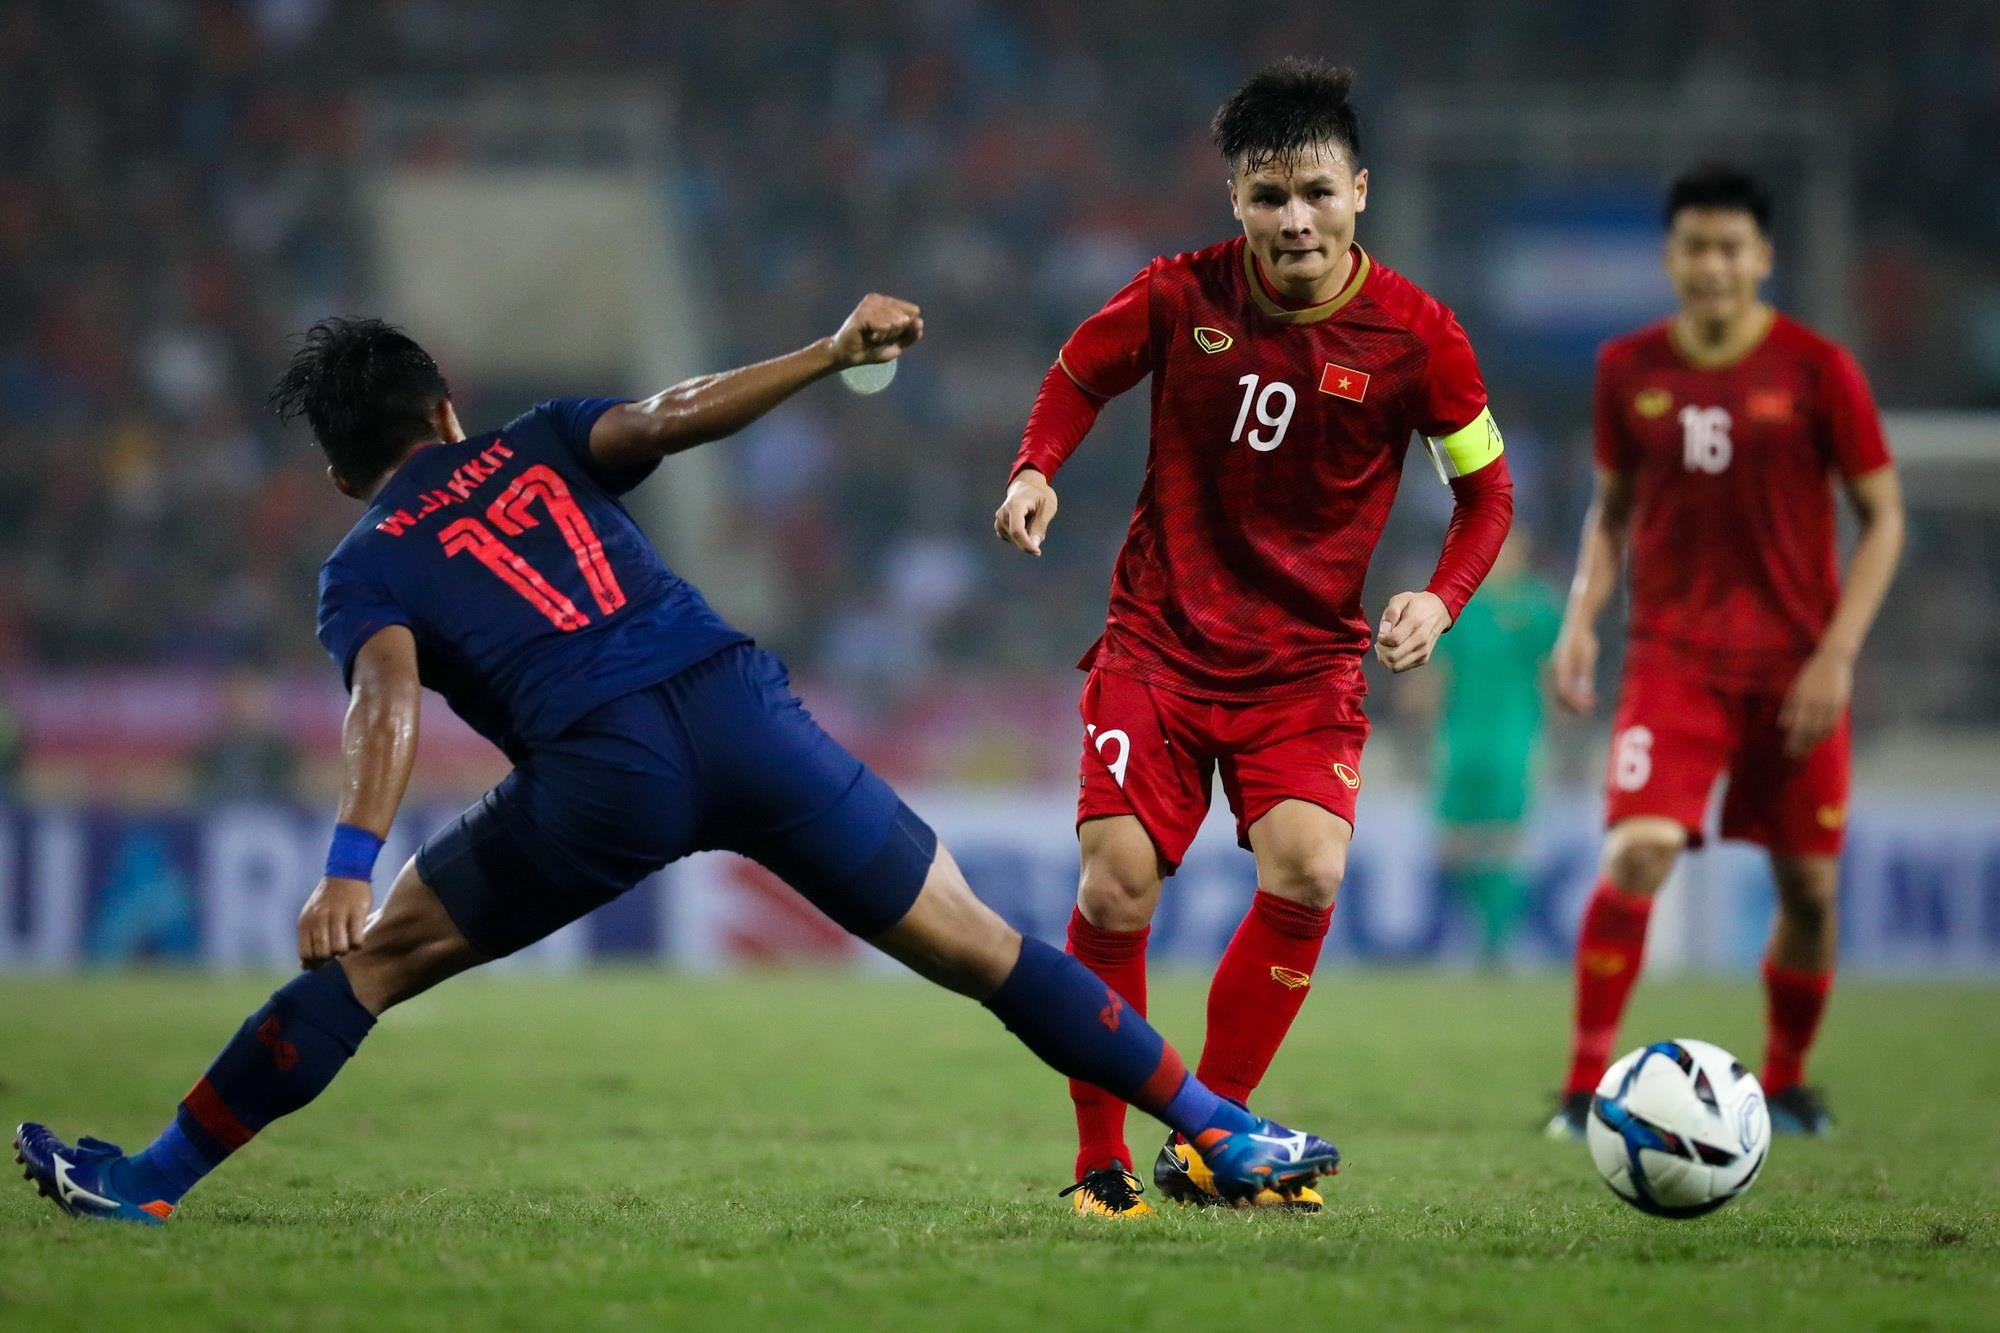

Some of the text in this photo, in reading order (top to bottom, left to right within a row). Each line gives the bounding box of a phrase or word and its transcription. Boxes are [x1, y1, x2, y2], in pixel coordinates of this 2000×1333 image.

[1230, 373, 1297, 452] 19
[1678, 404, 1733, 475] 16
[375, 437, 514, 537] W.JAKKIT
[437, 463, 627, 632] 17
[1087, 724, 1130, 789] 9
